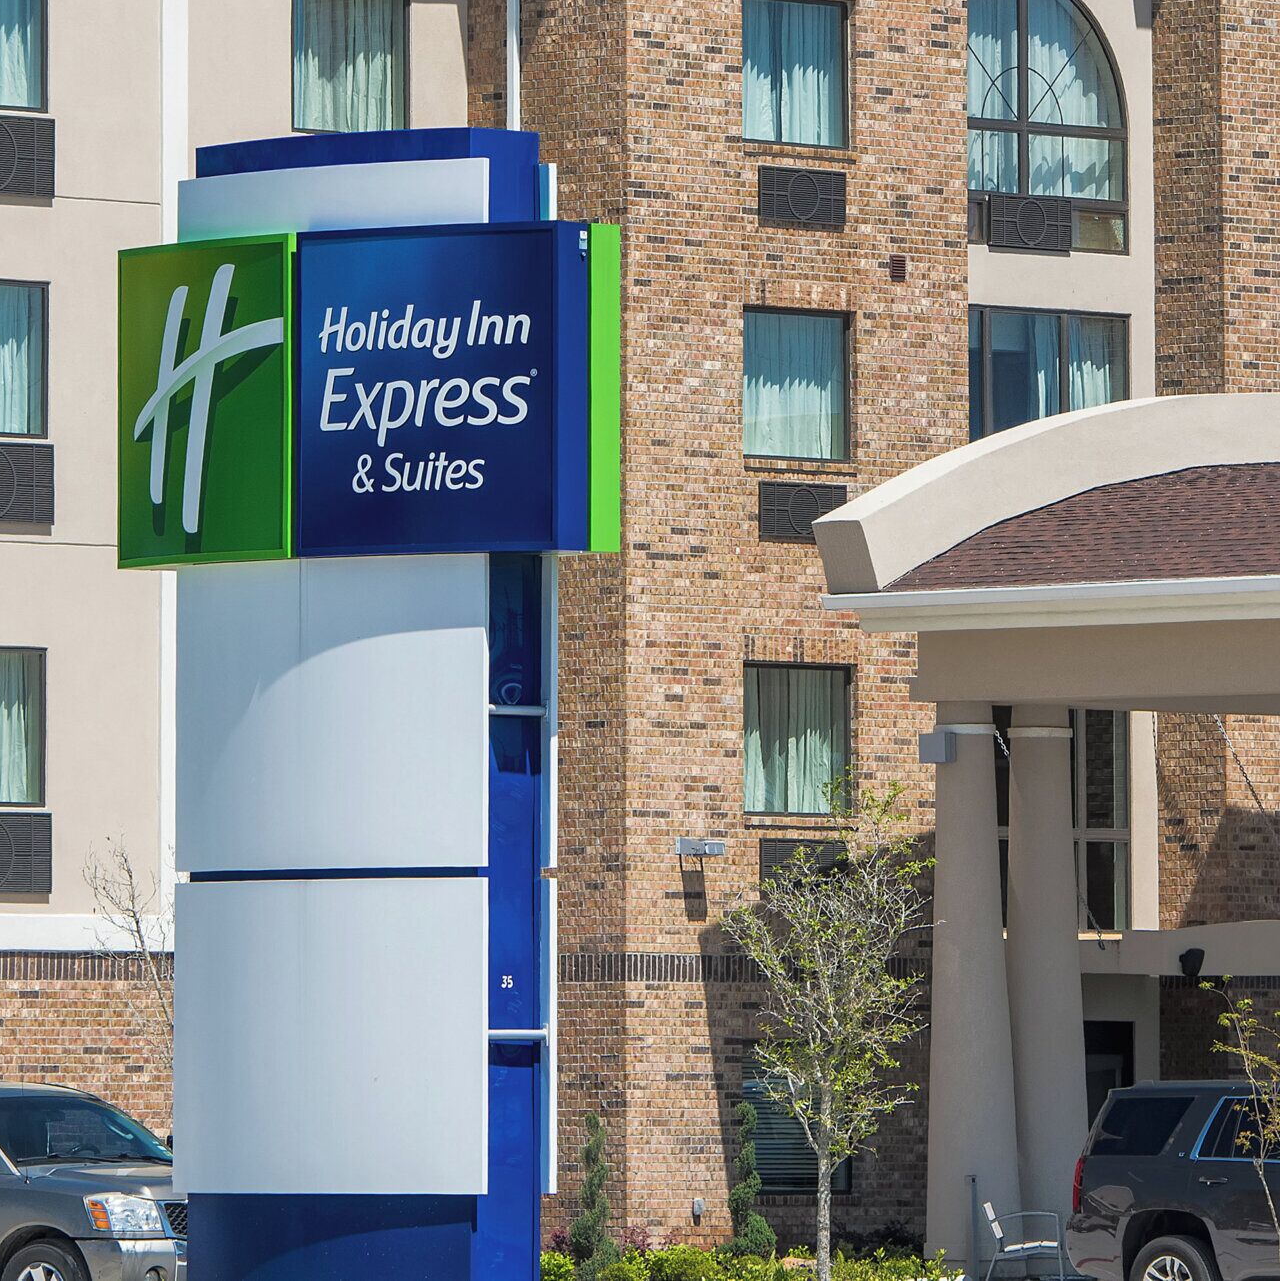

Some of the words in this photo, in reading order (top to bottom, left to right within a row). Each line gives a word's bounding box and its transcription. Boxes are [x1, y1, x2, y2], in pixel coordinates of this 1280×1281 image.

[318, 304, 461, 359] Holiday
[467, 300, 531, 346] Inn
[352, 453, 375, 494] &
[381, 452, 486, 493] Suites
[501, 975, 513, 989] 35
